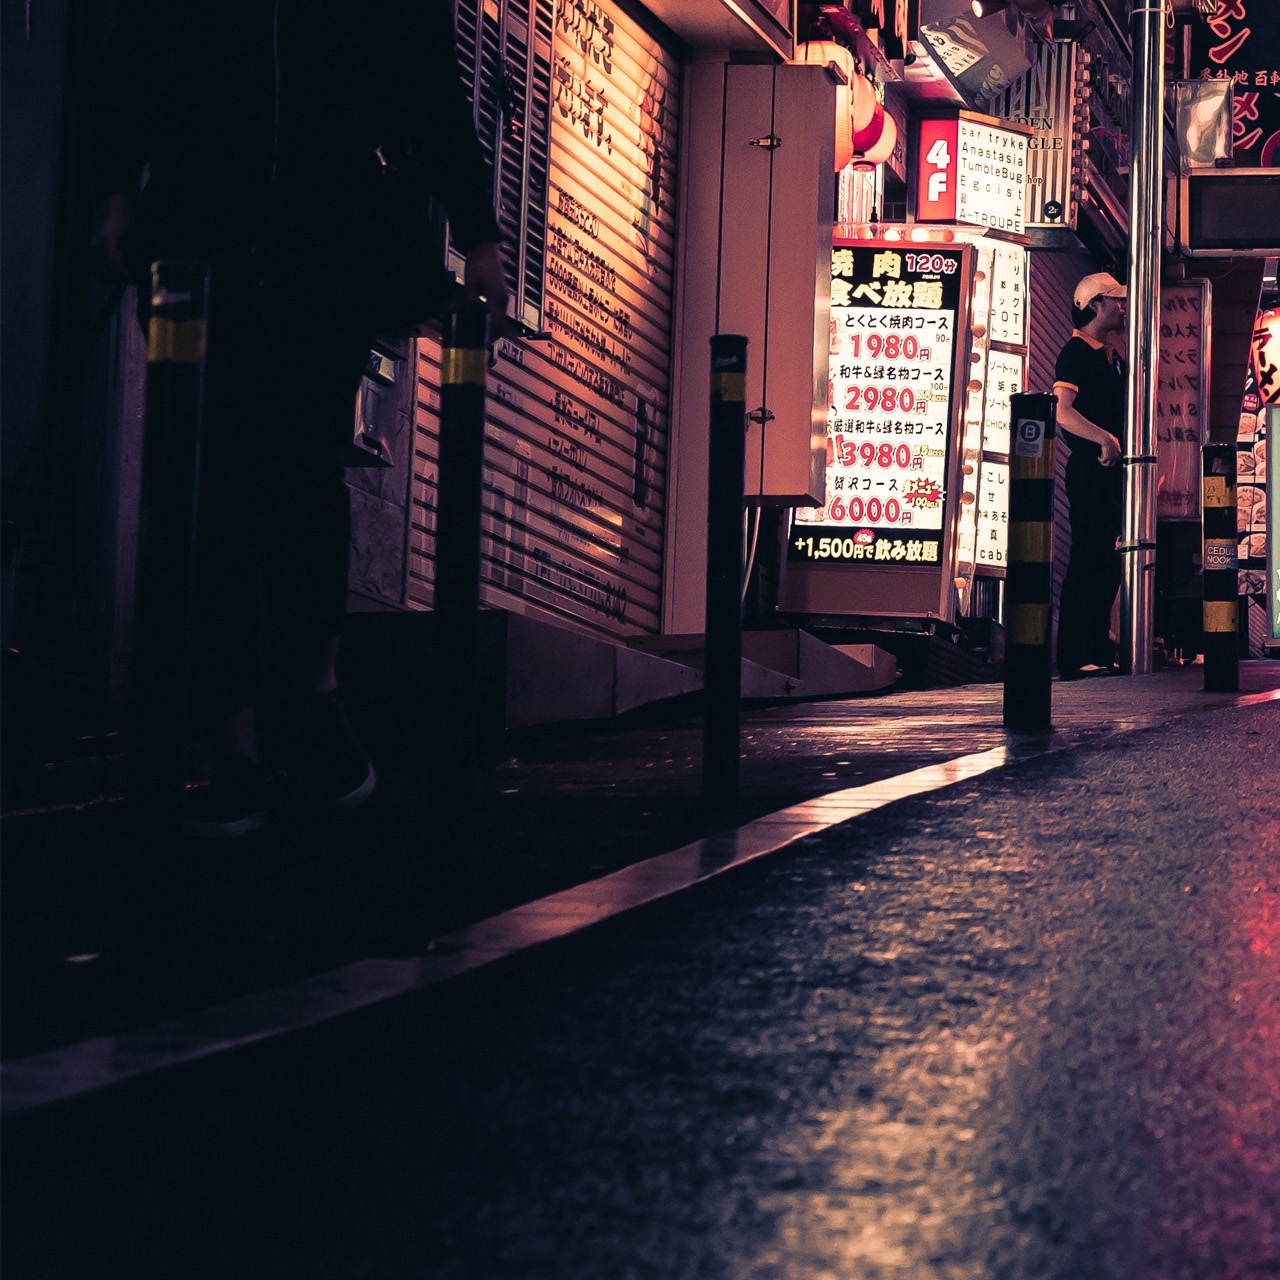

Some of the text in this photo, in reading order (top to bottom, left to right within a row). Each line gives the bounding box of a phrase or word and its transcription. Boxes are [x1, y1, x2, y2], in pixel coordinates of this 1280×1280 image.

[961, 125, 1025, 151] bar tryke
[961, 141, 1024, 167] Anastasia
[926, 139, 950, 202] 4F
[961, 157, 1023, 184] TumbleBug
[960, 207, 1021, 233] A-TROUPE
[905, 253, 957, 275] 120分
[845, 313, 949, 330] とくとく焼肉コース
[849, 333, 932, 362] 1980円
[935, 333, 950, 344] 90
[845, 386, 928, 415] 2980円
[930, 382, 949, 394] 100
[842, 442, 924, 470] 3980円
[830, 496, 913, 524] 6000円
[795, 537, 939, 562] +1,500円で飲み放題
